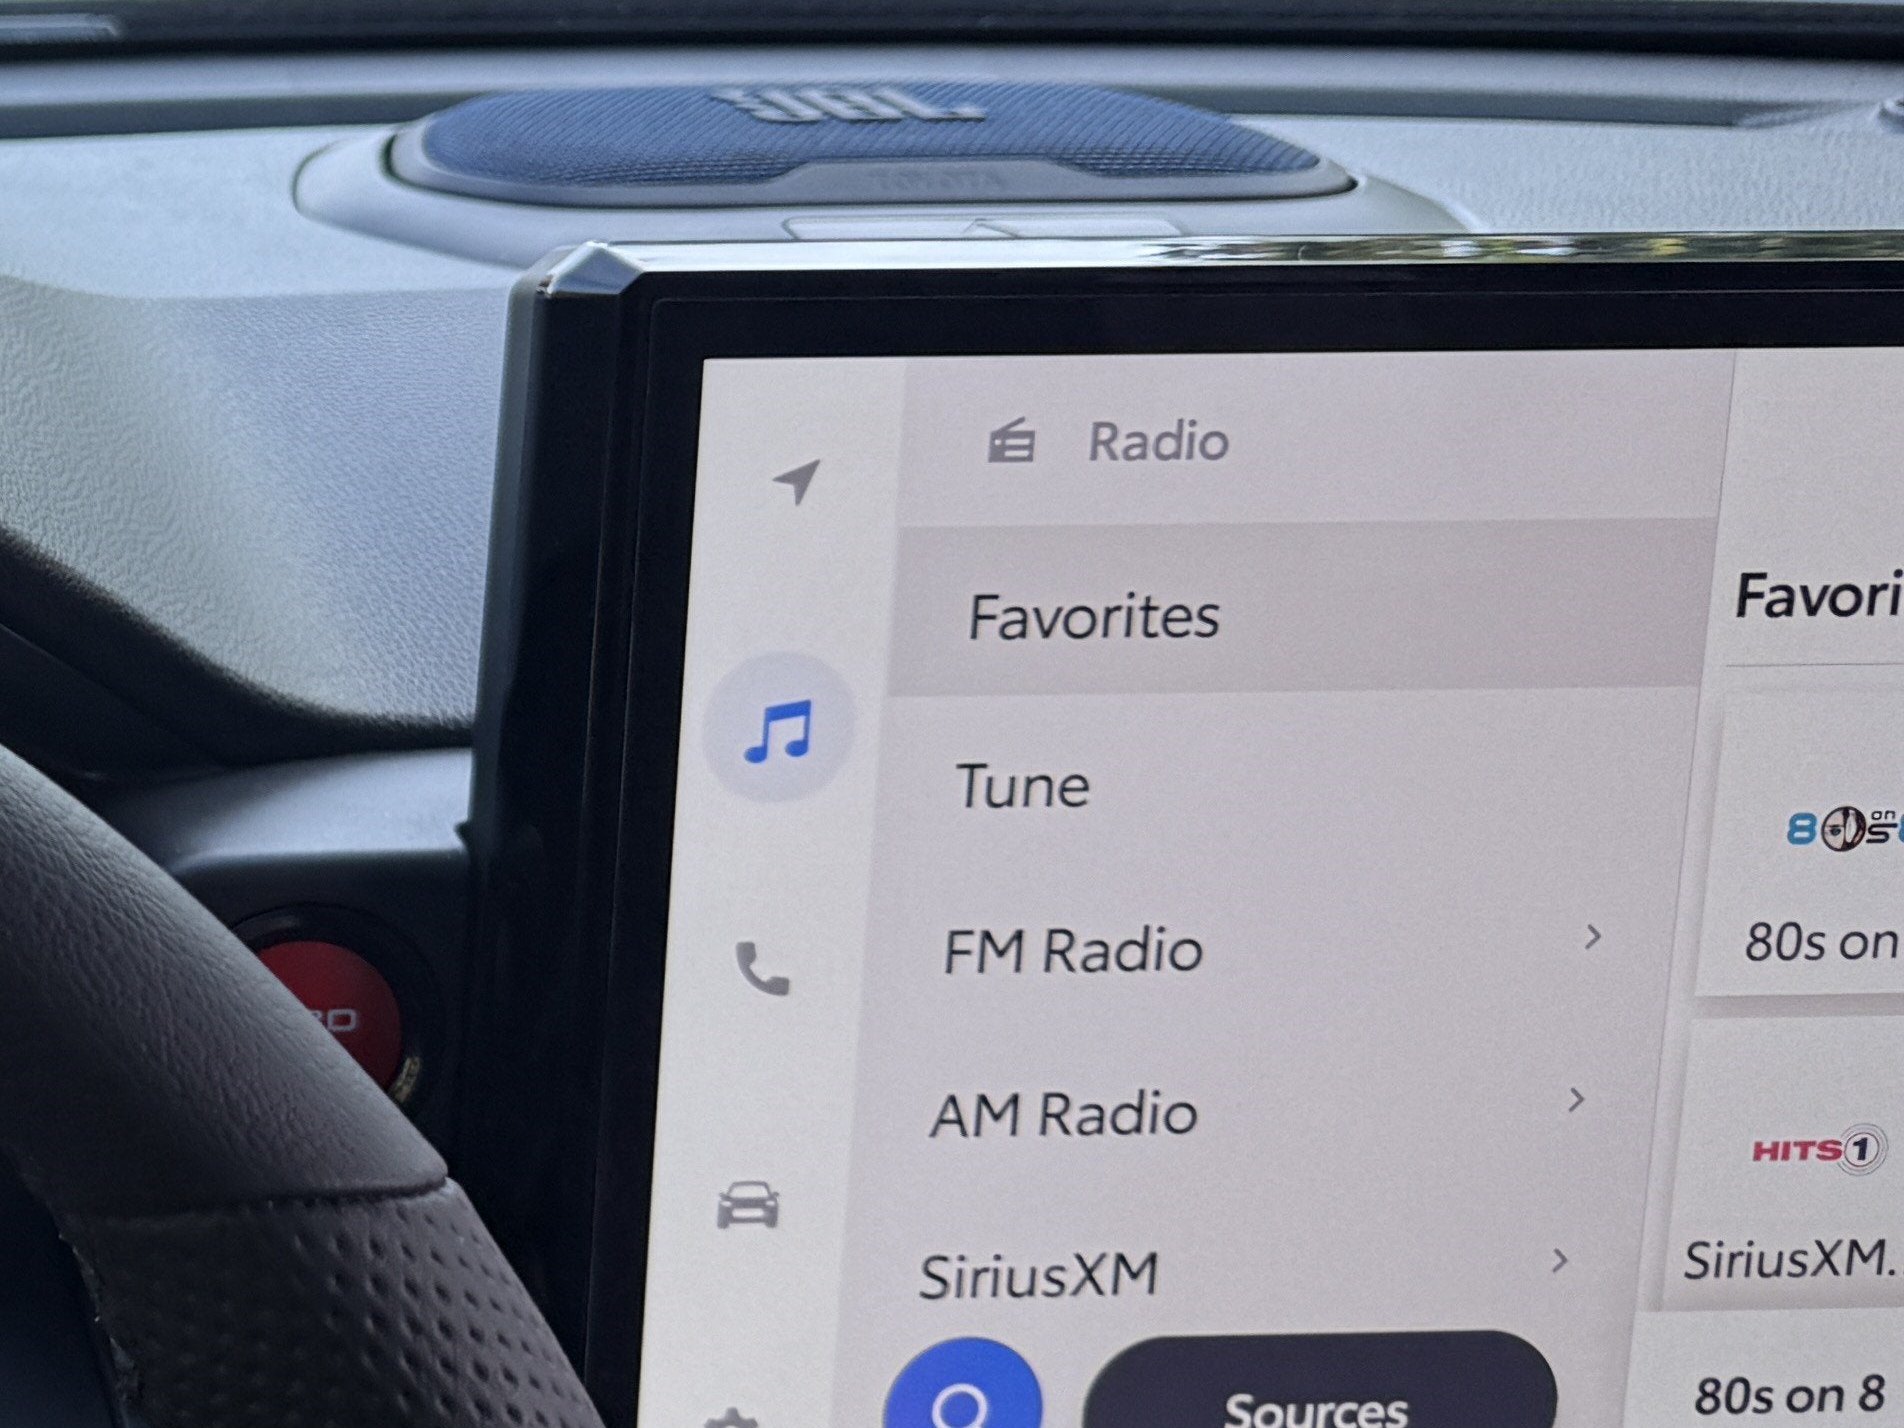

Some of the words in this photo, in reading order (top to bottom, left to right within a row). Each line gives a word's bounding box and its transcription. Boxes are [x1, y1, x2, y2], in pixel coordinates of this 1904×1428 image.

[1089, 418, 1231, 463] Radio
[969, 592, 1221, 642] Favorites
[1735, 568, 1904, 619] Favori
[956, 762, 1091, 810] Tune
[944, 929, 1024, 975] FM
[1044, 925, 1204, 974] Radio
[1745, 920, 1826, 962] 80s
[1839, 930, 1899, 961] on
[928, 1093, 1021, 1139] AM
[1039, 1089, 1199, 1137] Radio
[1752, 1139, 1844, 1162] HITS
[918, 1250, 1159, 1301] SiriusXM
[1695, 1376, 1774, 1416] 80s
[1785, 1385, 1845, 1414] on
[1858, 1373, 1886, 1412] 8
